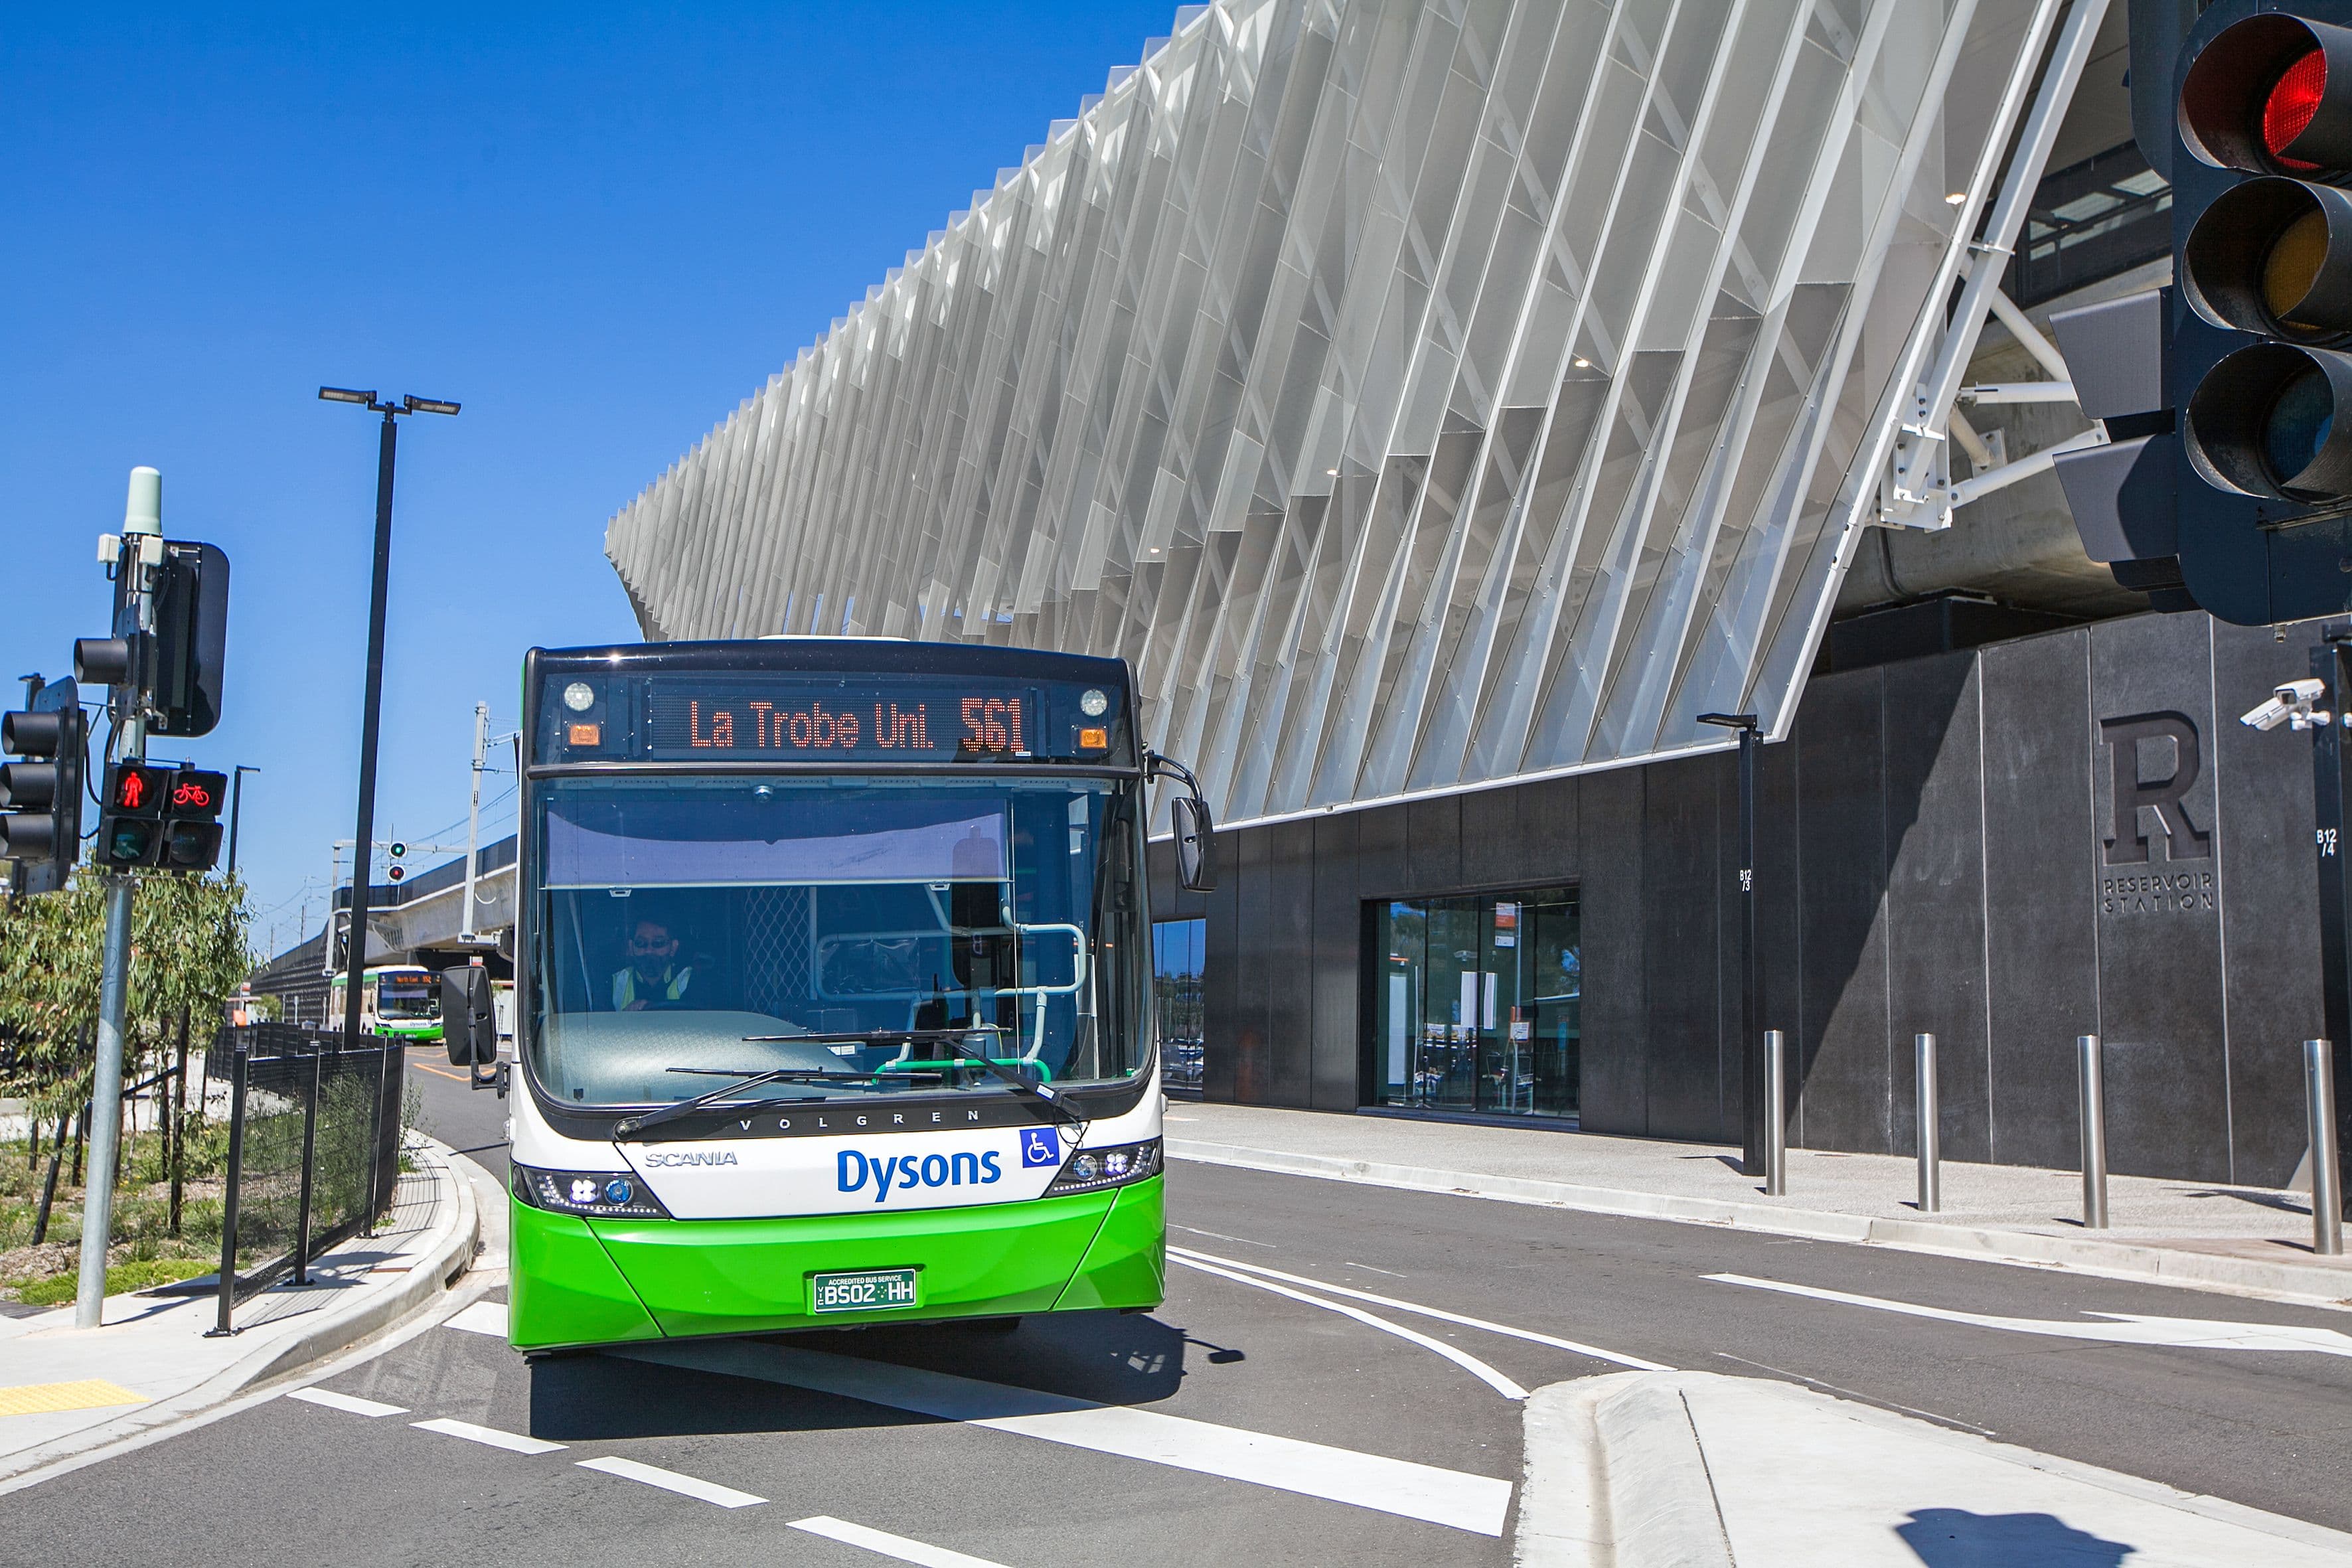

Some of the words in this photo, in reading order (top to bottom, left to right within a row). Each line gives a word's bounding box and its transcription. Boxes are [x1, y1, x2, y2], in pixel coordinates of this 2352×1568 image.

[691, 701, 733, 747] La
[750, 701, 859, 747] Trobe
[876, 704, 933, 748] Uni.
[961, 698, 1024, 752] 561
[2098, 710, 2211, 866] R
[2316, 828, 2337, 844] B12
[2321, 842, 2335, 857] /4
[1739, 869, 1752, 882] B12
[2103, 872, 2213, 896] RESERVOIR
[1742, 880, 1751, 892] /3
[2103, 892, 2213, 913] STATION
[740, 1110, 979, 1131] VOLGREN
[645, 1151, 738, 1168] SCANIA
[837, 1150, 1002, 1203] Dysons
[828, 1277, 864, 1286] ACCREDITED
[878, 1275, 902, 1283] SERVICE
[888, 1281, 913, 1301] HH
